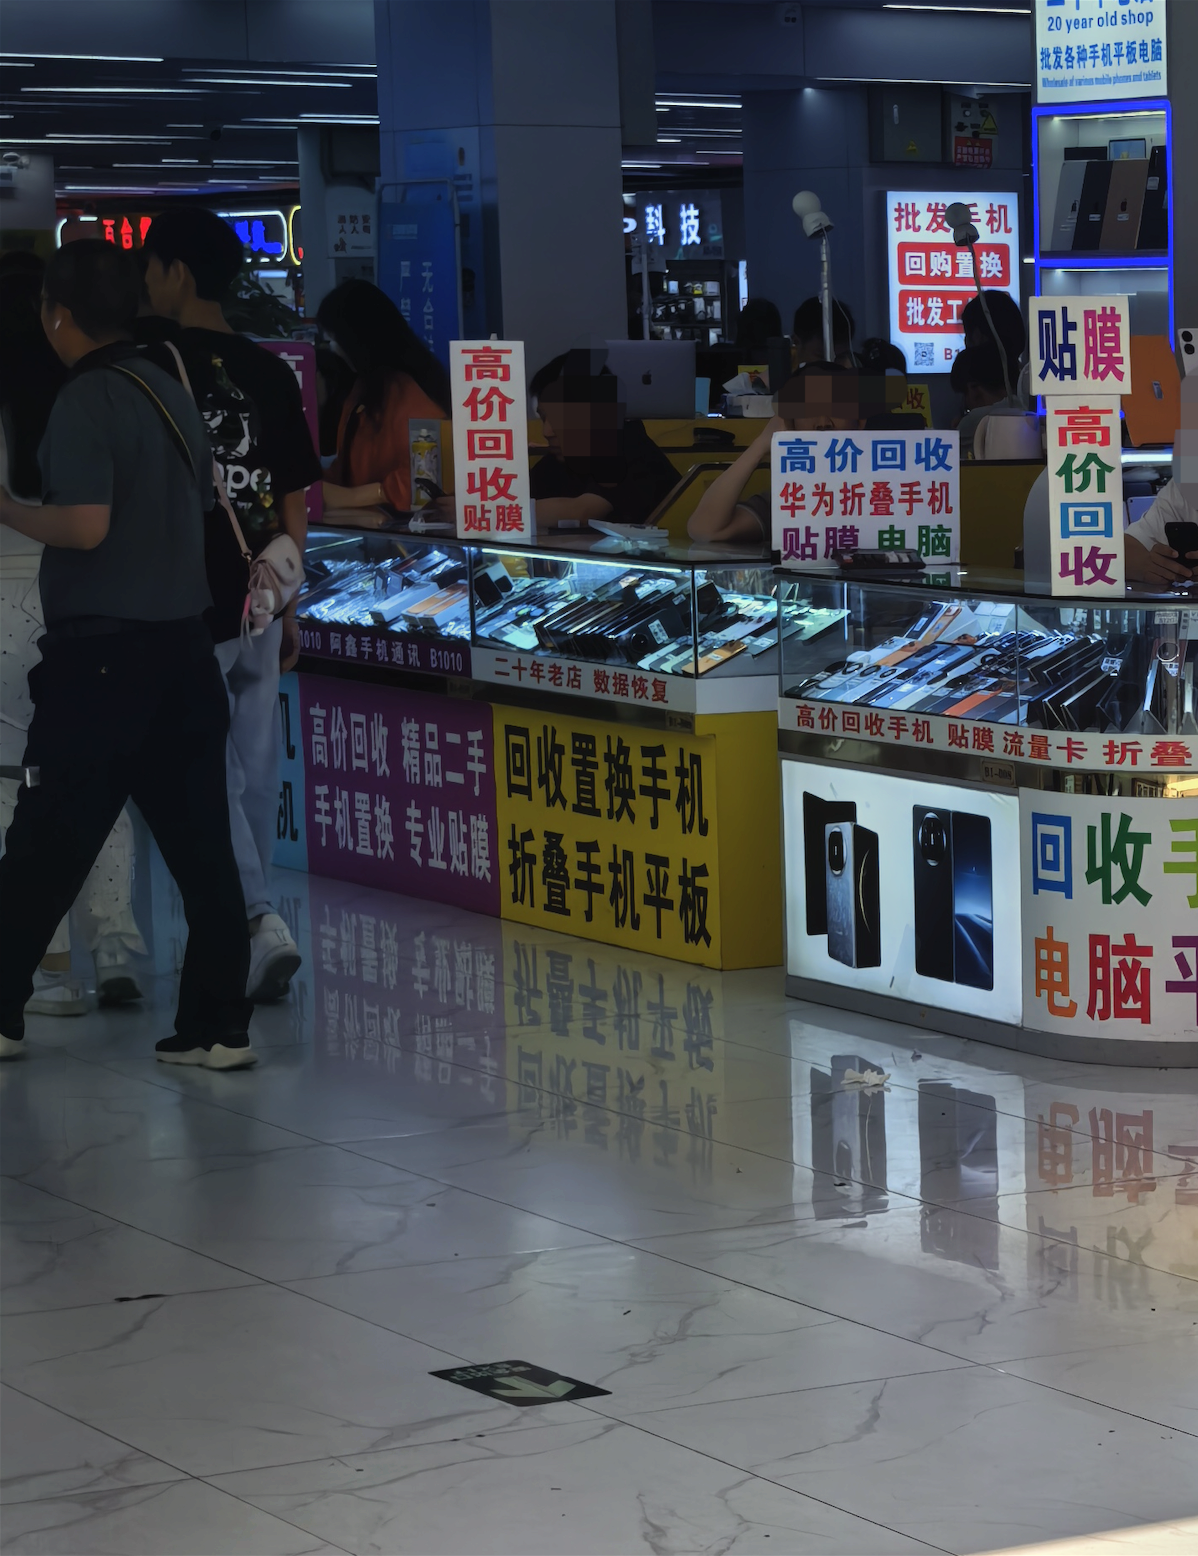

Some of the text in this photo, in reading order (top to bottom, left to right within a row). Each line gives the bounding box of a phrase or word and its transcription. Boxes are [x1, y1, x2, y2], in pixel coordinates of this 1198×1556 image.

[1047, 9, 1154, 34] 20 year old shop
[1040, 38, 1162, 70] 批发各种手机平板电脑
[644, 203, 702, 246] 科技
[904, 251, 1003, 279] 回购置换
[1037, 305, 1125, 383] 贴膜
[461, 345, 519, 503] 高价回收
[778, 436, 954, 475] 高价回收
[462, 504, 525, 534] 贴膜
[780, 480, 954, 518] 华为折叠手机
[1054, 405, 1118, 587] 高价回收
[782, 524, 953, 562] 贴膜 电脑
[329, 632, 421, 669] 阿鑫手机通讯
[429, 650, 464, 673] B1010
[494, 652, 583, 690] 二十年老店
[592, 667, 670, 704] 数据恢复
[309, 701, 391, 779] 高价回收
[401, 716, 487, 797] 精品二手
[796, 704, 934, 744] 高价回收手机
[947, 723, 994, 752] 贴膜
[1002, 729, 1088, 765] 流量卡
[504, 723, 709, 838] 回收置换手机
[313, 784, 492, 885] 手机置换 专业贴膜
[508, 823, 712, 949] 折叠手机平板
